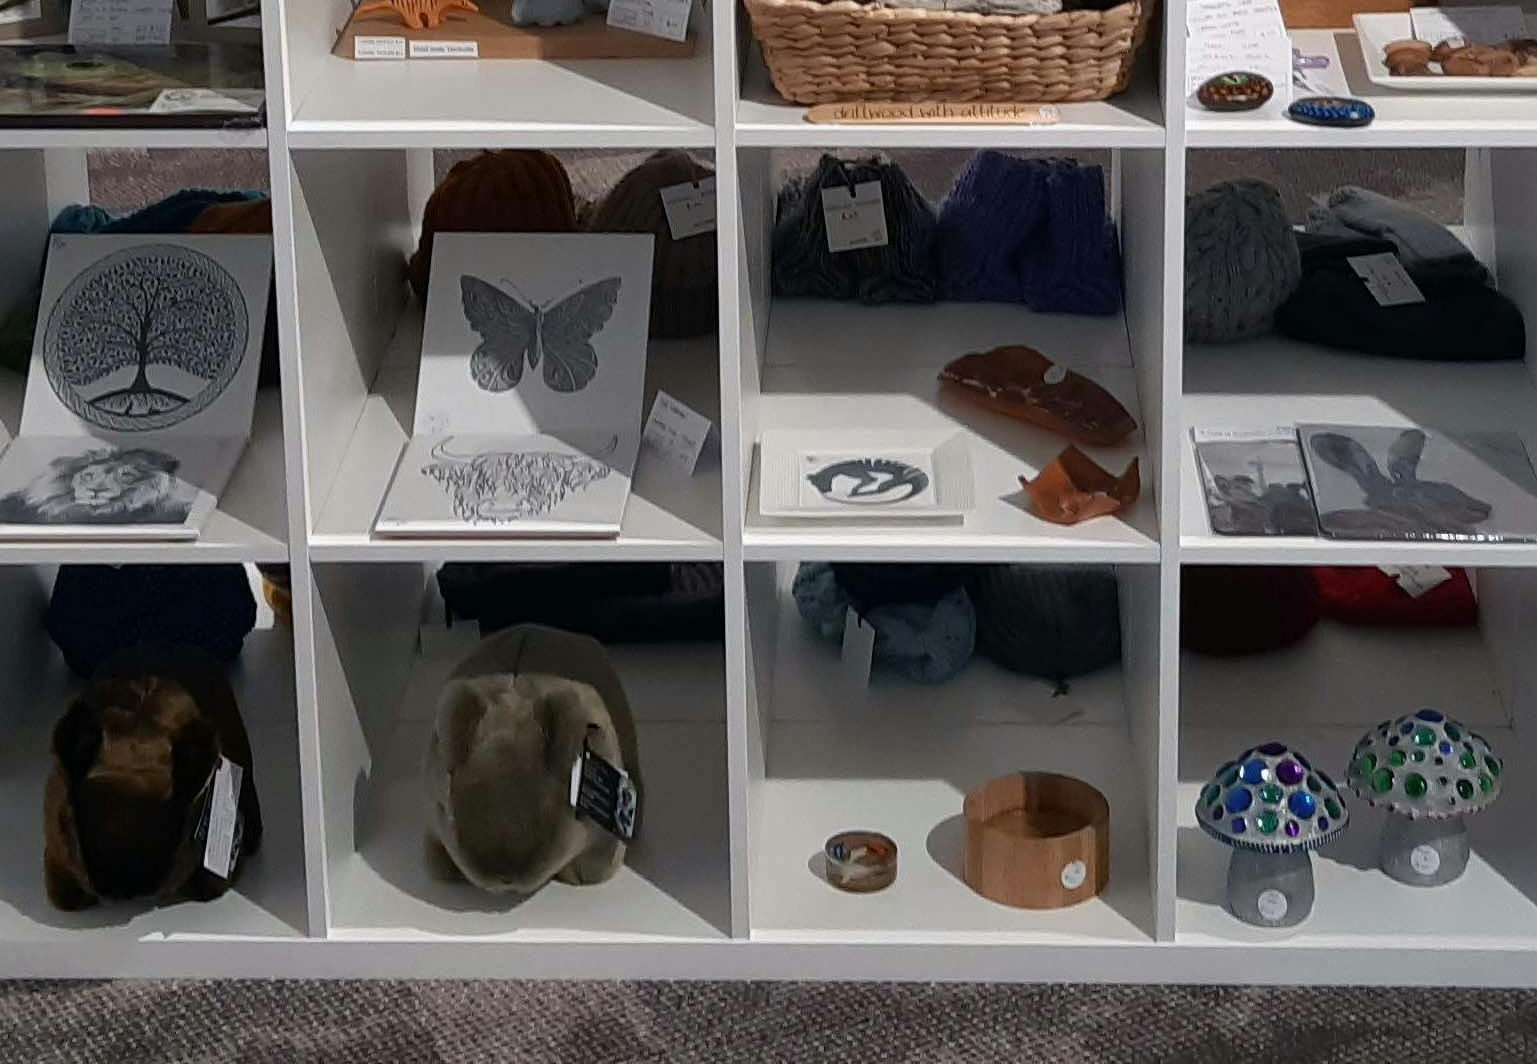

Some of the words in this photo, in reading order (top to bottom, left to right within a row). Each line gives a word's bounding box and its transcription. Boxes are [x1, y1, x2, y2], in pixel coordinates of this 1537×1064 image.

[833, 104, 913, 120] driftwood
[919, 104, 954, 119] with
[959, 104, 1023, 120] attitude
